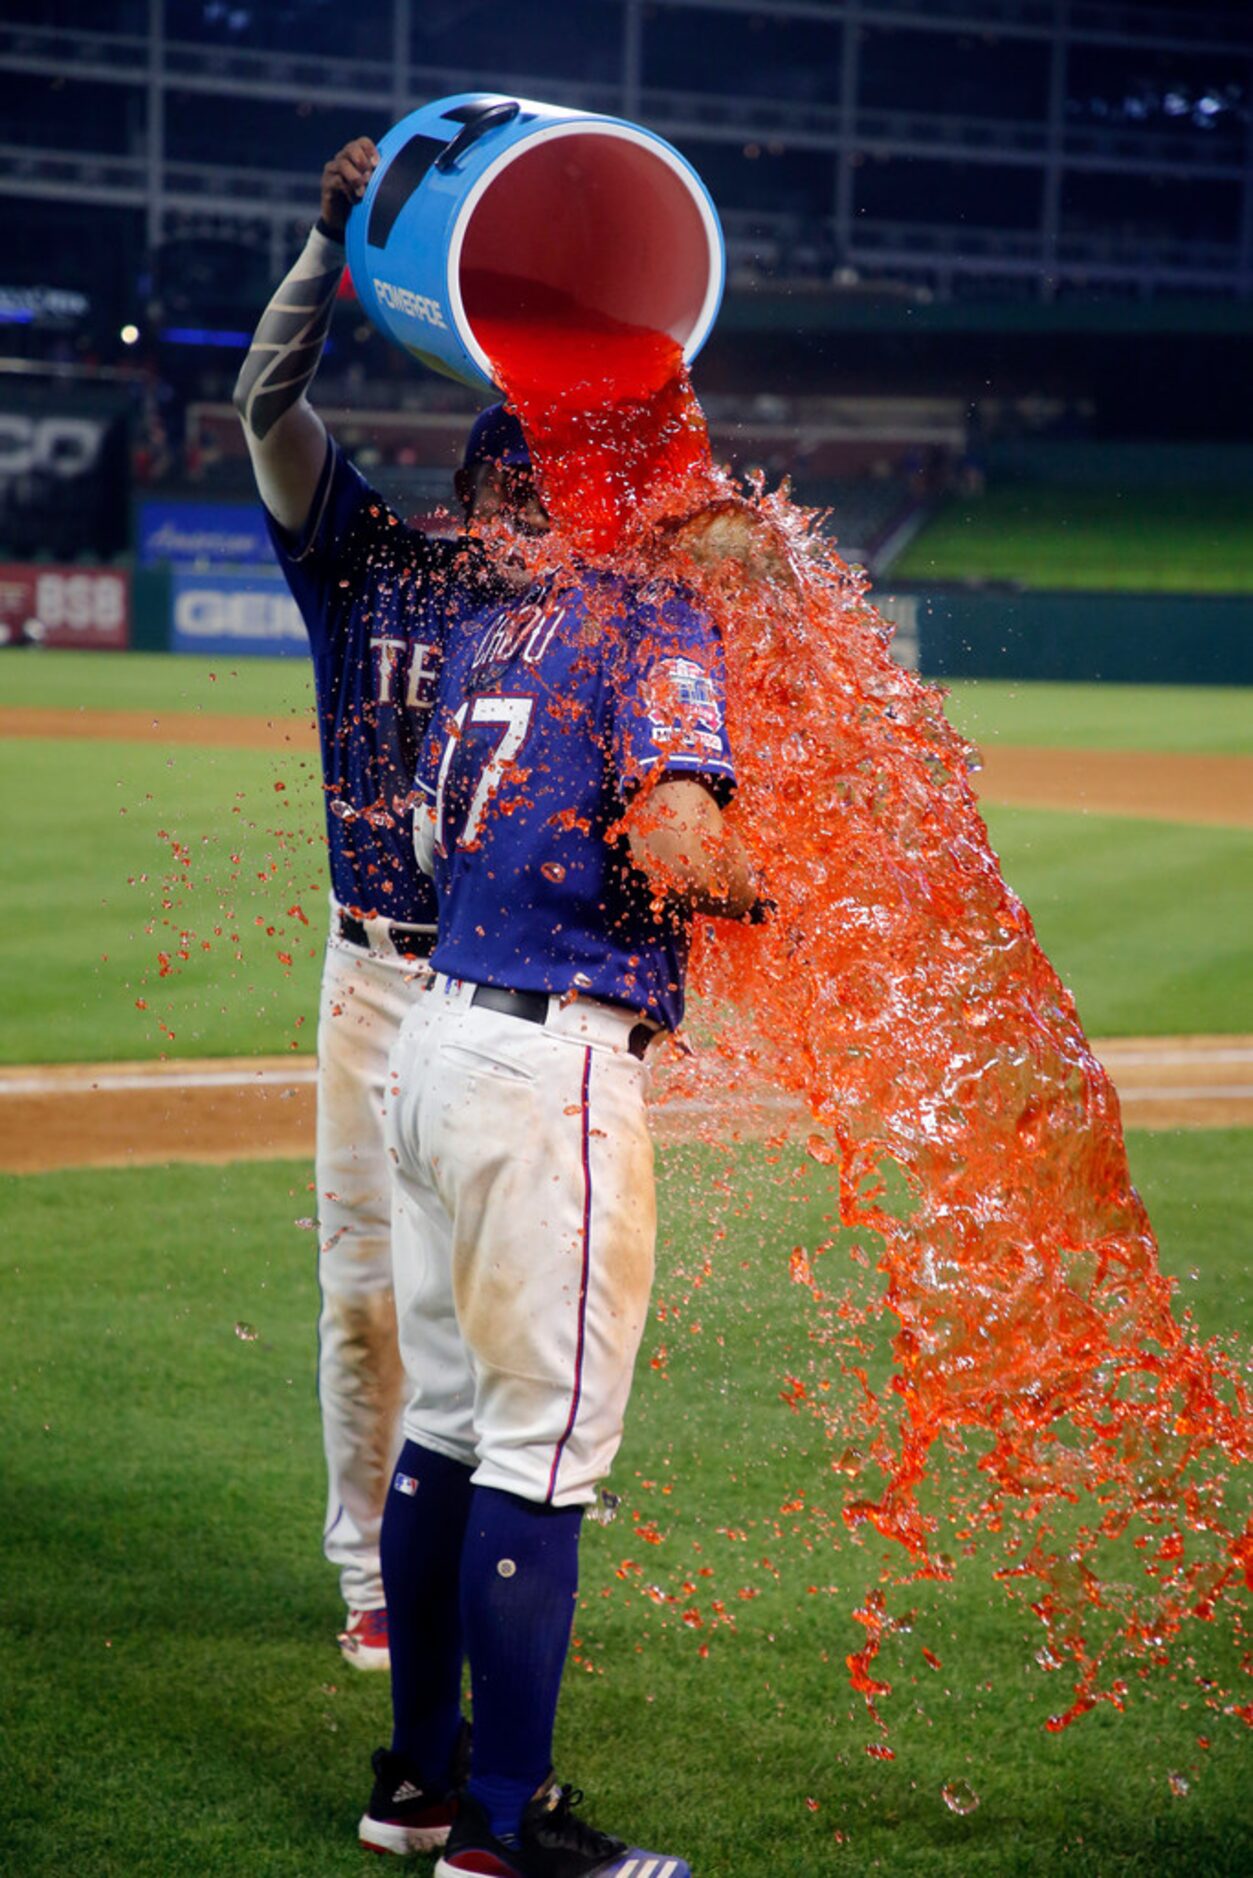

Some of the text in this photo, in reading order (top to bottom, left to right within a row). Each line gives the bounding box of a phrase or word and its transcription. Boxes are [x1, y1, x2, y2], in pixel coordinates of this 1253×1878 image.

[372, 278, 449, 330] POWERADE
[37, 573, 125, 630] BSB
[435, 696, 535, 856] 17
